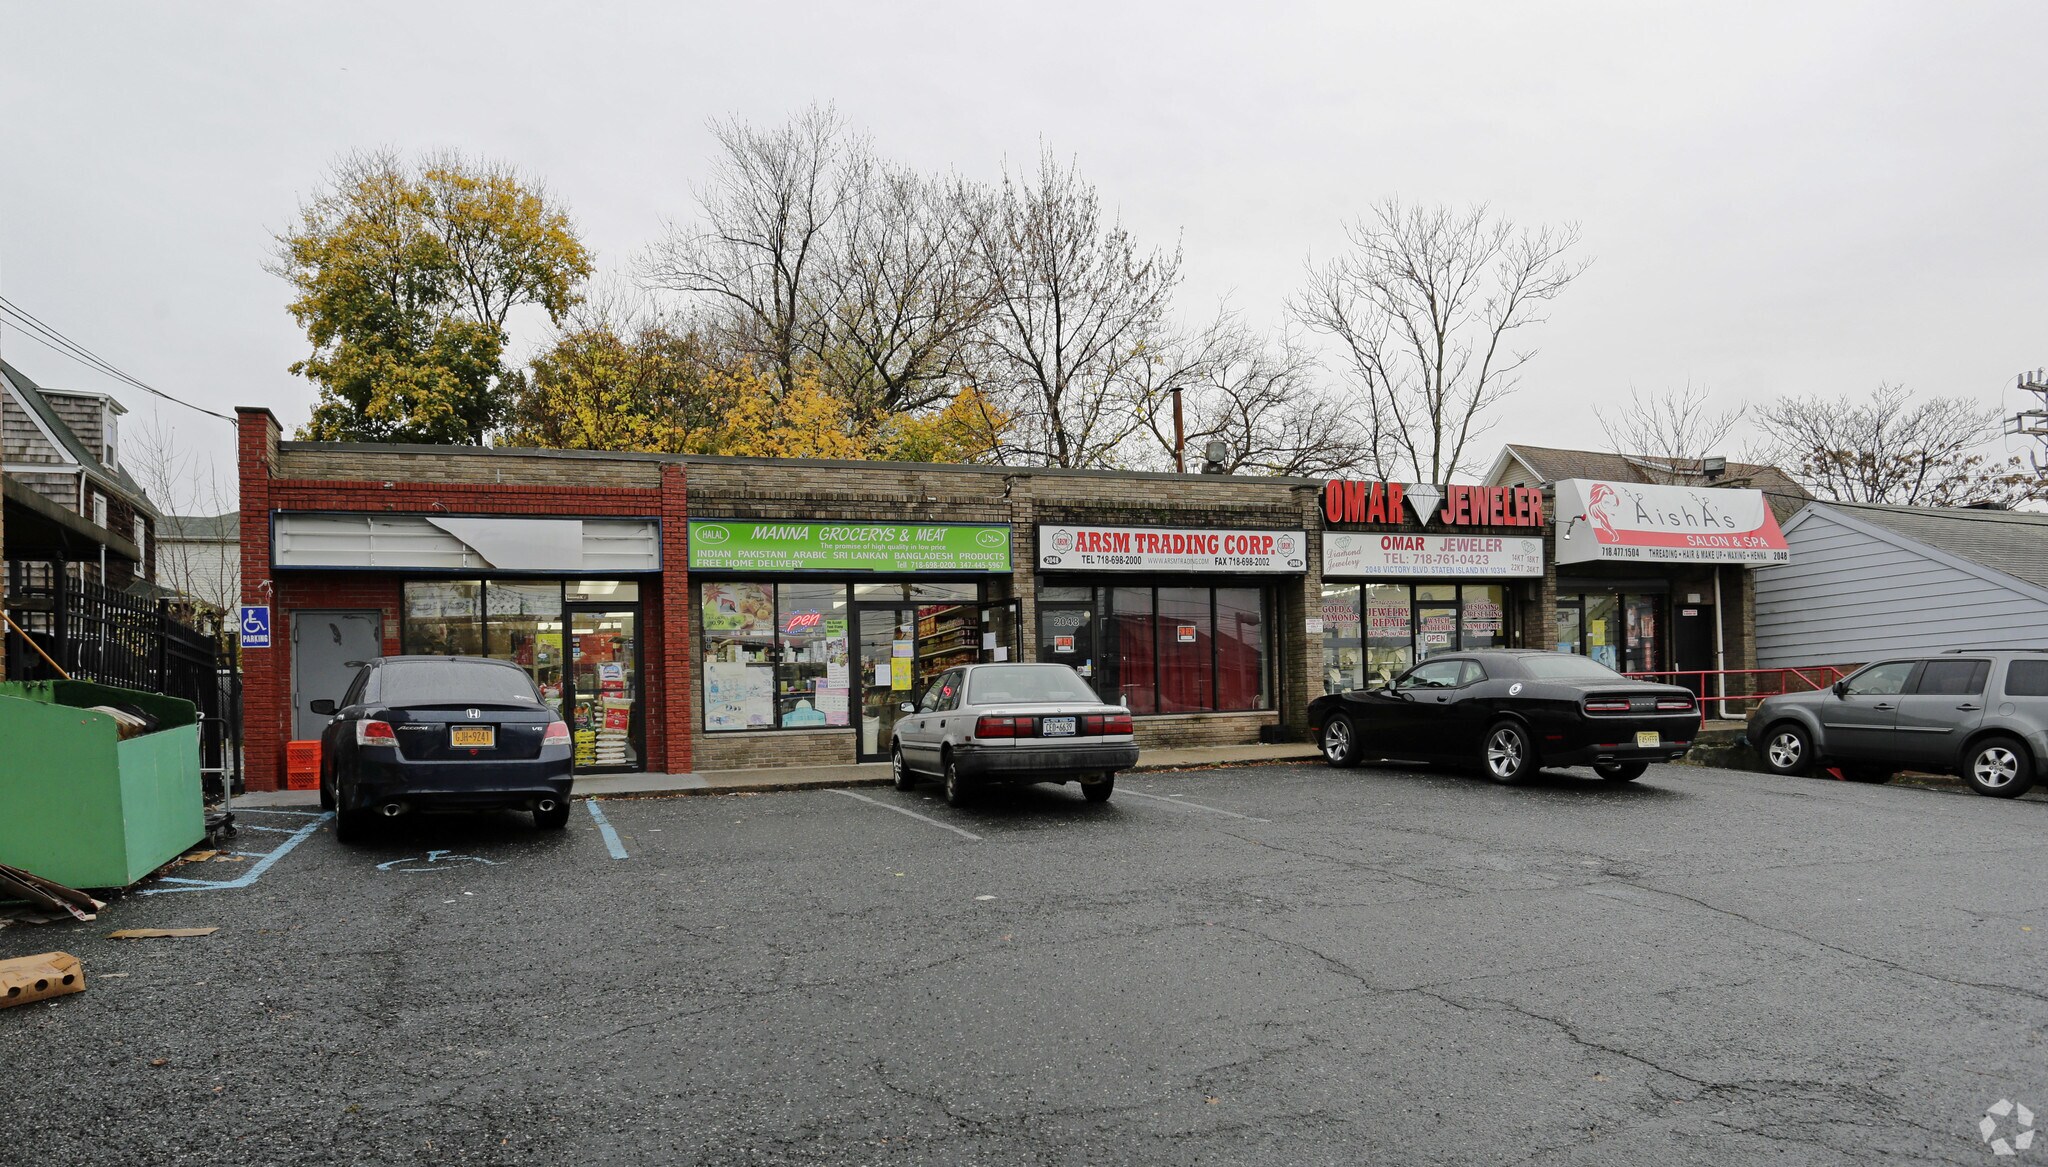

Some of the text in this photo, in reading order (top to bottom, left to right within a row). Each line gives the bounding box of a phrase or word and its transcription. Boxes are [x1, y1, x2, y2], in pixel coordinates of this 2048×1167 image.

[1326, 479, 1544, 526] OMAR JEWELER
[703, 530, 723, 539] HALAL
[751, 526, 948, 541] MANNA GROCERYS & MEAT
[1075, 531, 1275, 555] ARSM TRADING CORP.
[1381, 536, 1503, 552] OMAR JEWELER
[1687, 535, 1768, 548] SALON & SPA
[835, 543, 861, 551] promise
[871, 544, 886, 552] high
[888, 544, 909, 552] quality
[1327, 546, 1362, 558] Diamond
[697, 550, 732, 558] INDIAN
[738, 550, 787, 558] PAKISTANI
[794, 551, 827, 559] ARABIC
[851, 552, 888, 560] LANKAN
[895, 552, 954, 560] BANGLADESH
[1602, 547, 1787, 560] 718.477.1504 THREADING HAIR & MAKE UP WAXING HENNA 2048
[697, 559, 721, 567] FREE
[726, 559, 754, 568] HOME
[758, 560, 804, 568] DELIVERY
[1082, 555, 1095, 564] TEL
[1097, 556, 1142, 565] 718-698-2000
[1214, 557, 1227, 566] FAX
[1229, 558, 1270, 566] 718-698-2002
[1384, 553, 1489, 565] TEL: 718-761-0423
[1431, 566, 1455, 574] STATEN
[1456, 566, 1480, 574] ISLAND
[1481, 566, 1489, 574] NY
[1322, 605, 1344, 613] GOLD
[1368, 607, 1409, 617] JEWELRY
[1054, 617, 1080, 626] 2048
[1372, 618, 1405, 627] REPAIR
[1421, 624, 1457, 632] BATTERIES
[243, 635, 268, 643] PARKING
